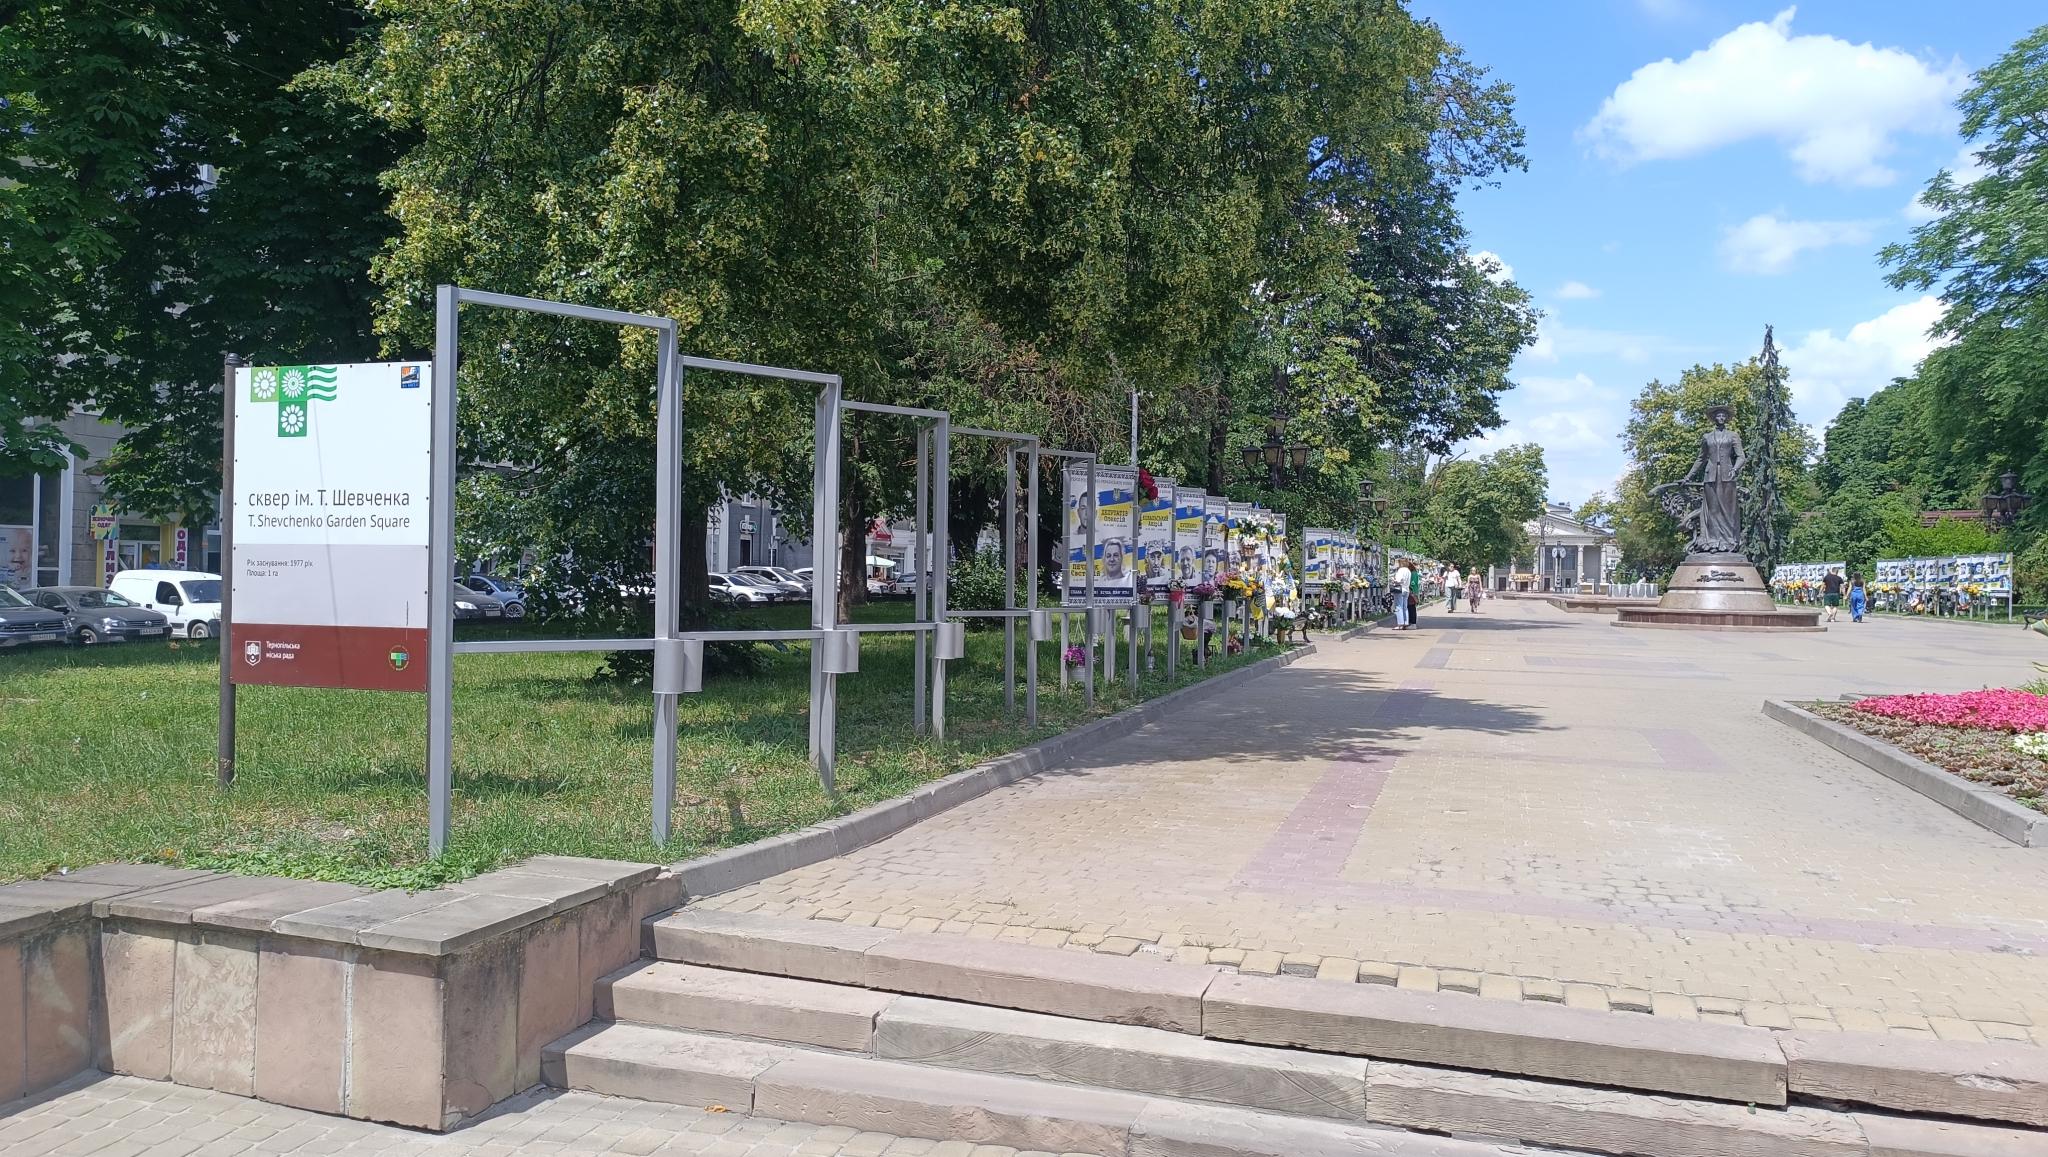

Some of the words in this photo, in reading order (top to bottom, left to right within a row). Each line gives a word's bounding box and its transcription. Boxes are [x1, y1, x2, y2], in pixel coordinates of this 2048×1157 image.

[248, 492, 290, 510] сквер
[295, 489, 313, 506] ім.
[317, 489, 328, 506] Т.
[332, 489, 410, 506] Шевченка
[326, 514, 366, 528] Garden
[370, 514, 410, 531] Square
[246, 558, 256, 567] Рік
[256, 560, 290, 568] заснування:
[290, 559, 303, 567] 1977
[304, 560, 313, 569] рік
[246, 569, 267, 577] Площа:
[266, 640, 301, 650] Тернопільська
[282, 652, 295, 660] рада
